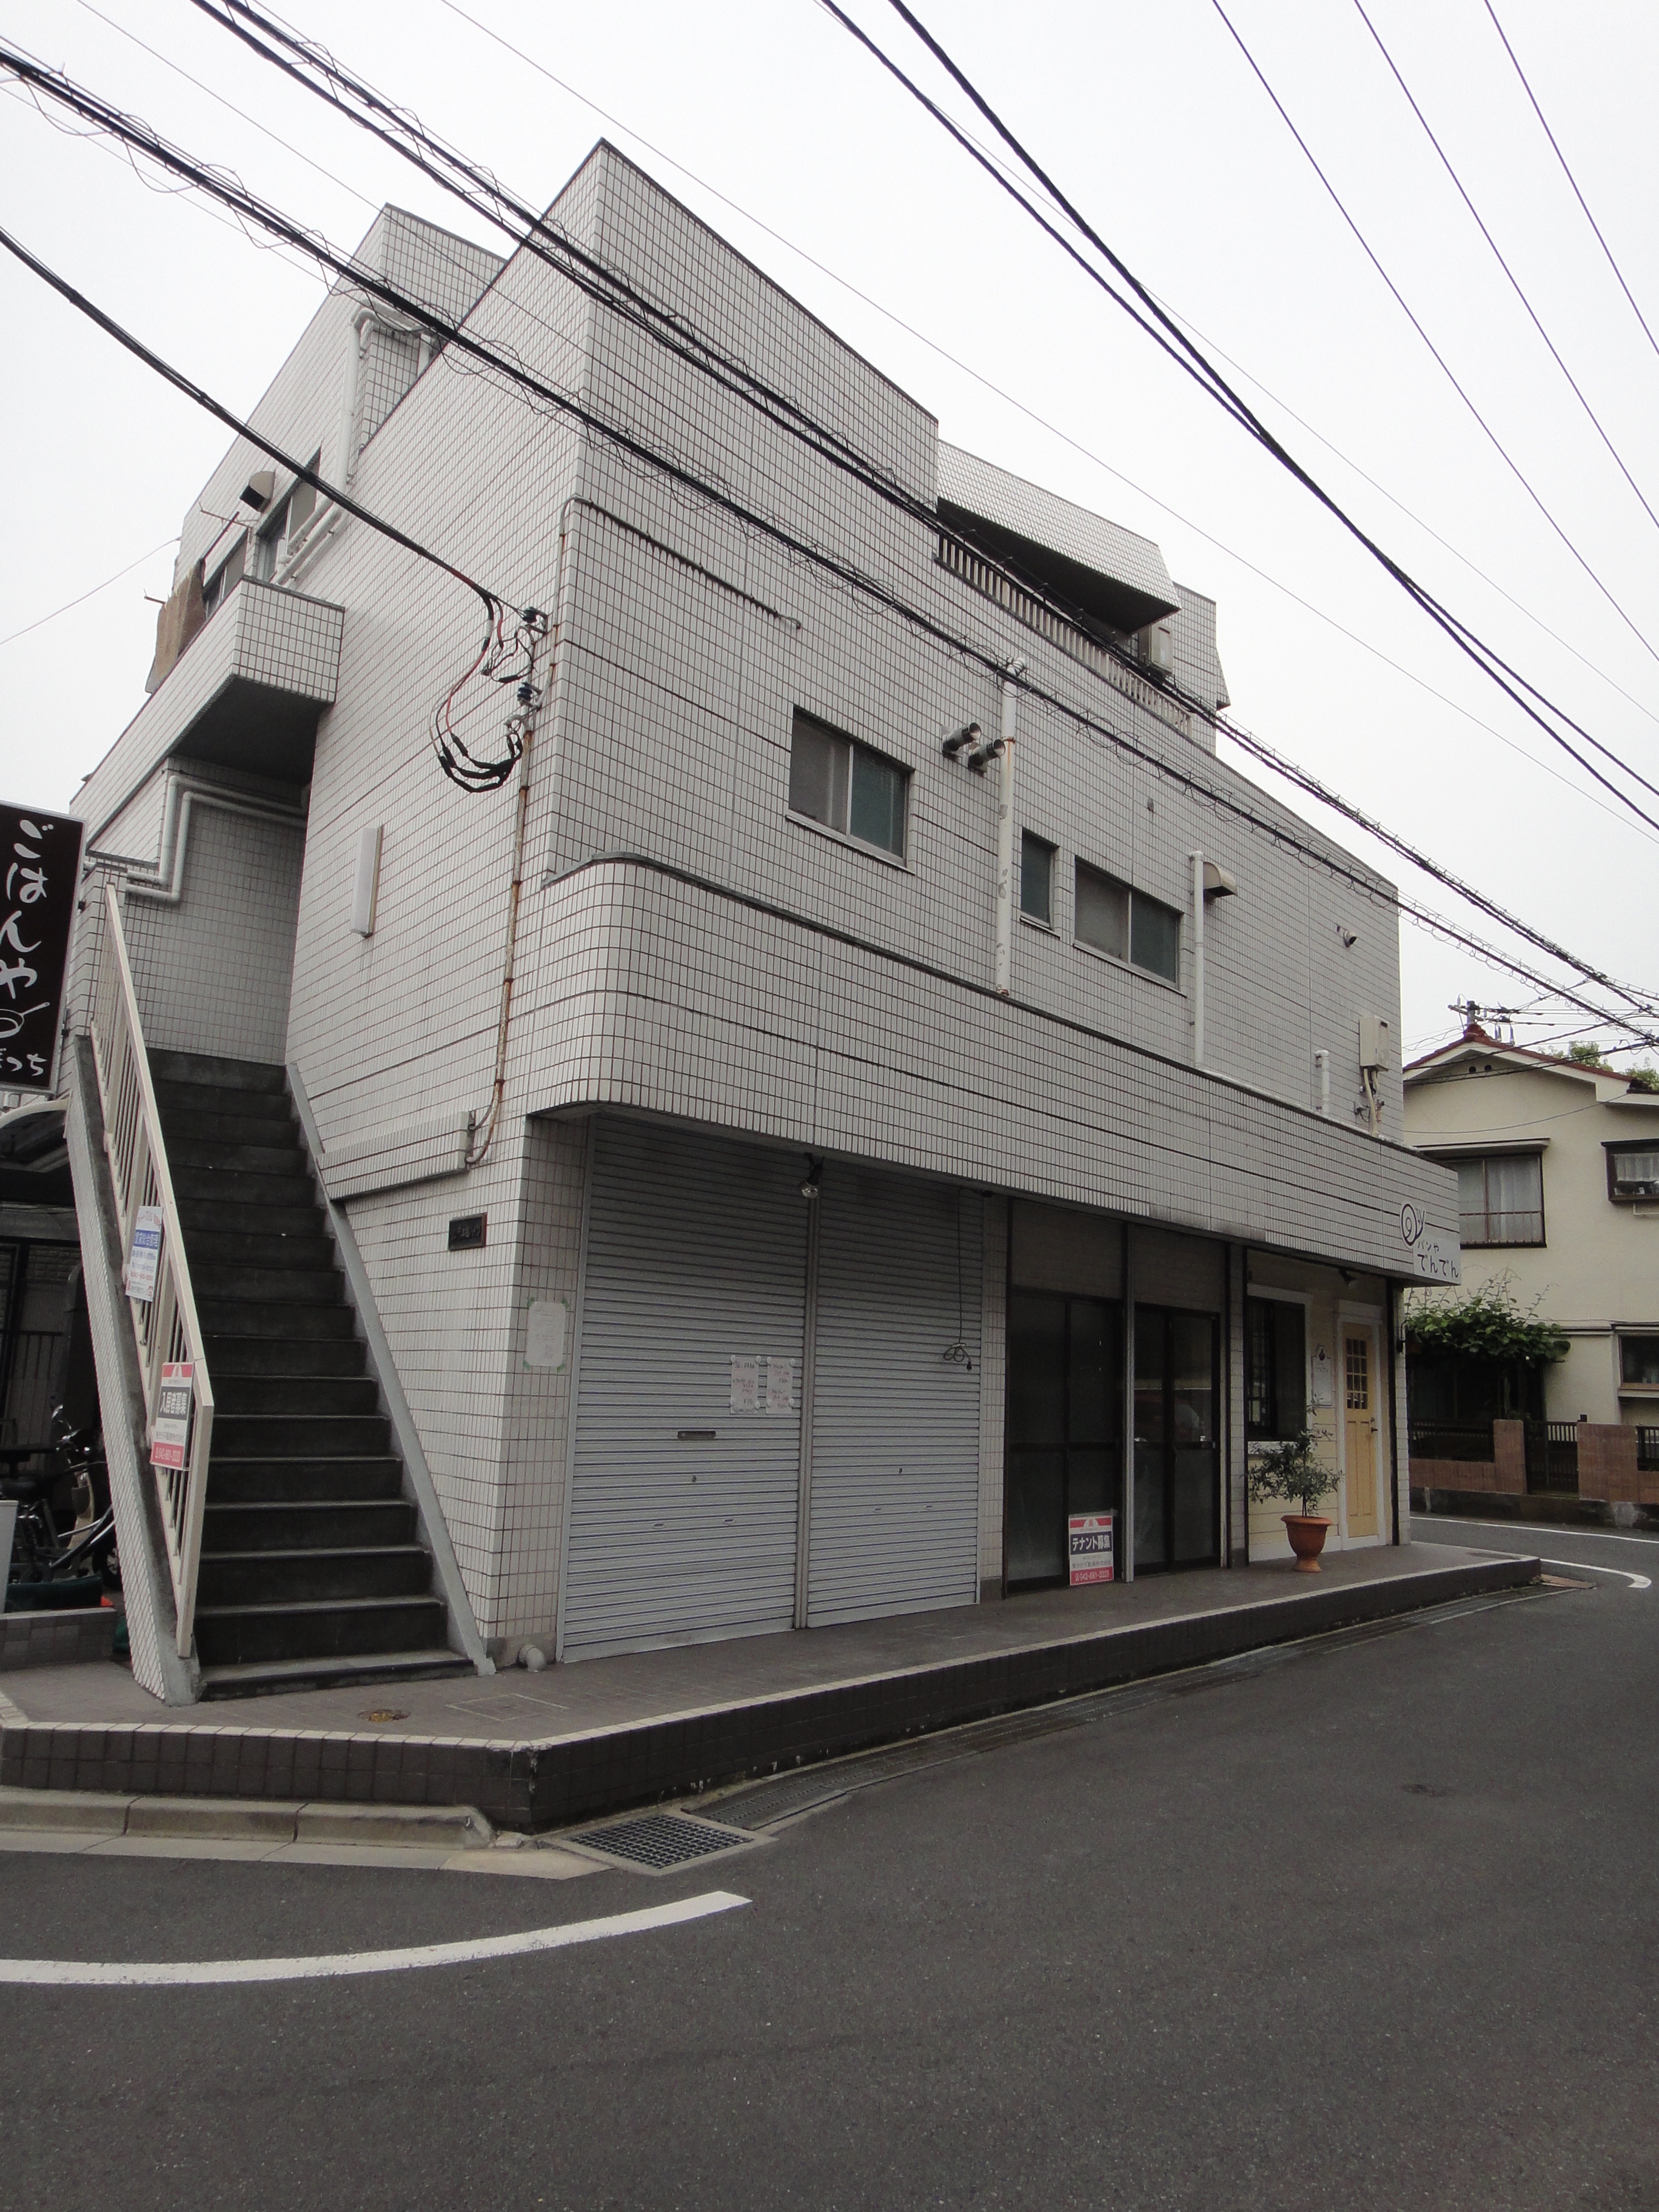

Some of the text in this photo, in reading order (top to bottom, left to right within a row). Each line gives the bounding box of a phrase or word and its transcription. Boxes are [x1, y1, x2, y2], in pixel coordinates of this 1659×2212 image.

[0, 1048, 47, 1076] っち
[1418, 1240, 1439, 1253] パンや
[1417, 1254, 1459, 1278] でんでん
[160, 1392, 188, 1416] 入居者募集
[1072, 1534, 1111, 1552] テナント募集
